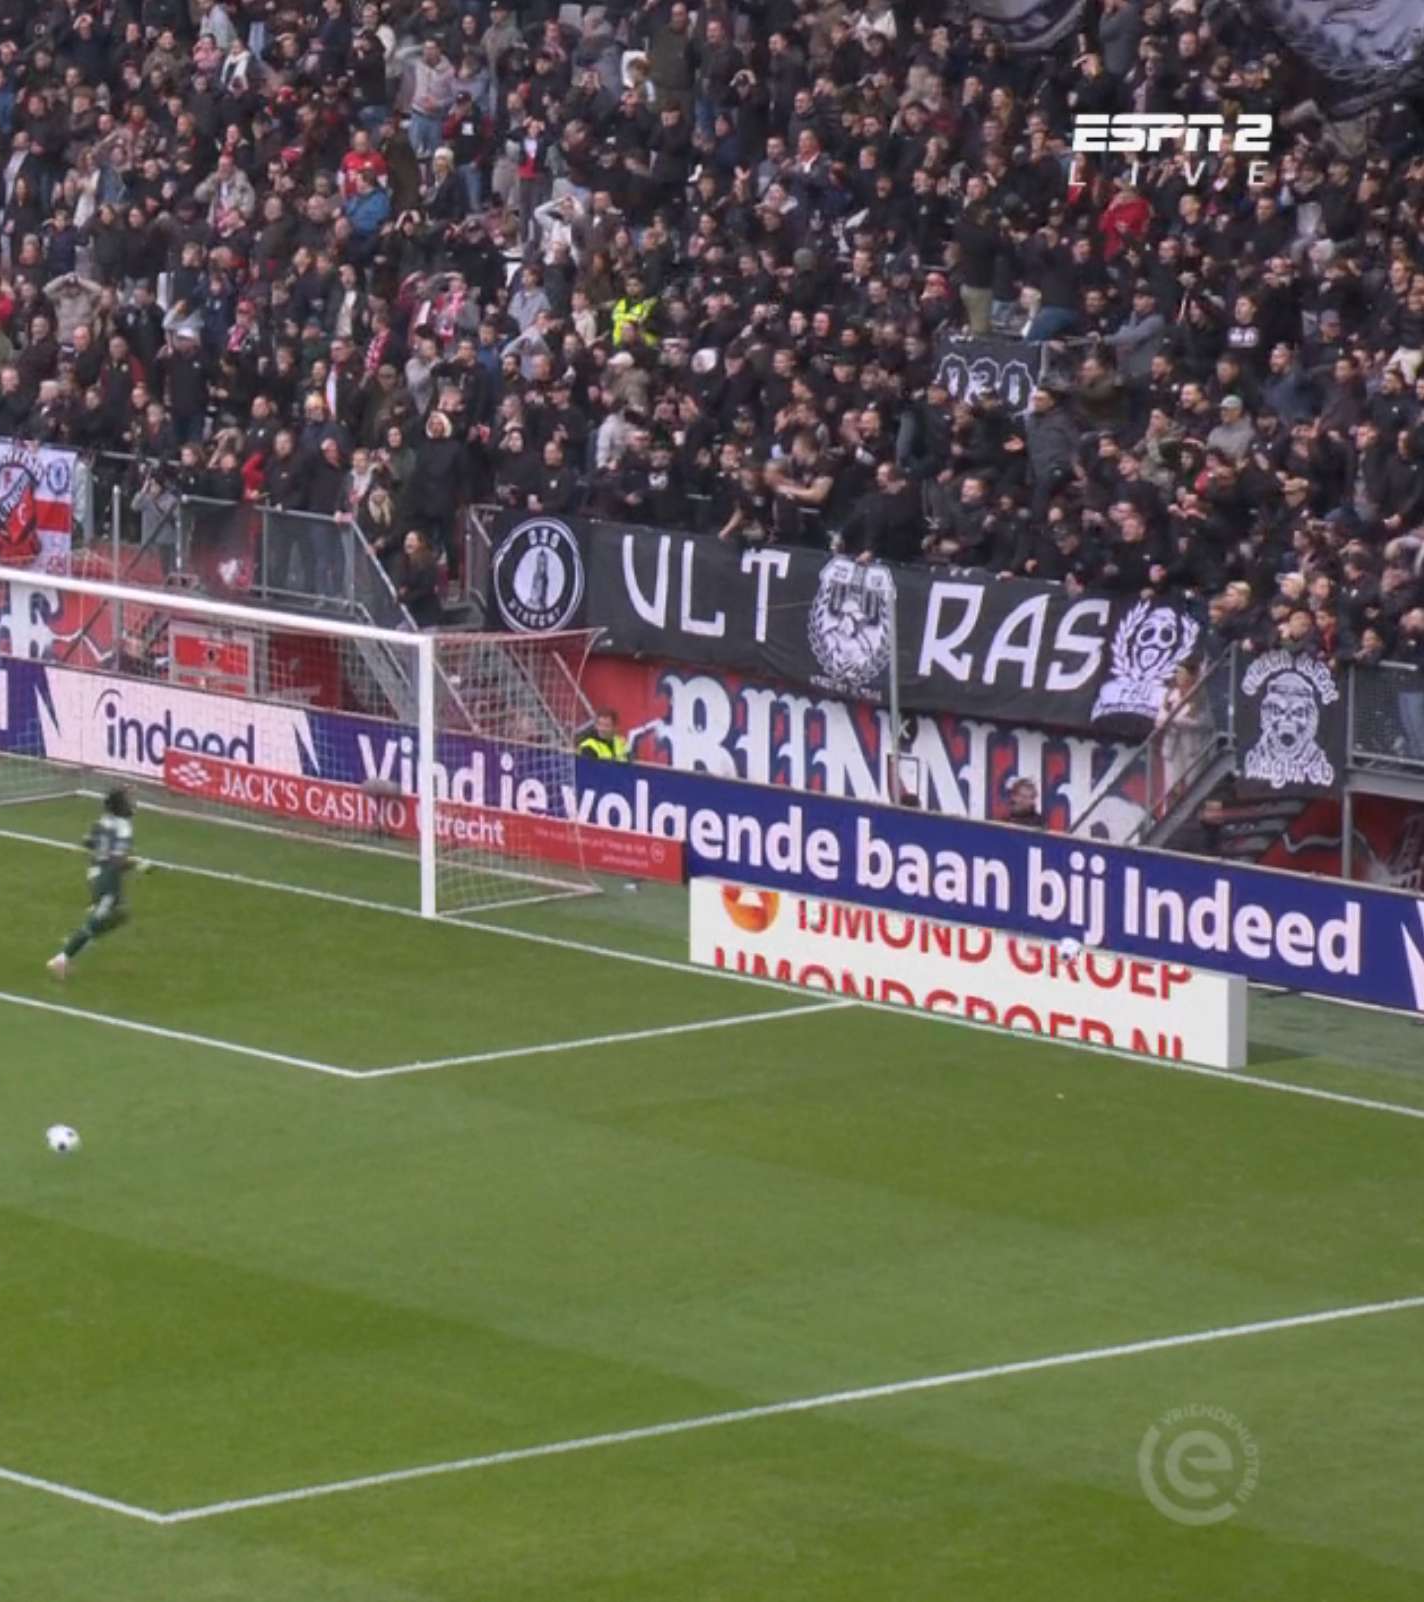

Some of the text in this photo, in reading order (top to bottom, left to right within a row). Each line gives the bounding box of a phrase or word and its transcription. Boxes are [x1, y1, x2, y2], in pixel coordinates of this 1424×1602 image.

[917, 581, 1111, 692] RAS
[220, 769, 299, 812] JACK'S
[305, 786, 407, 829] CASINO
[856, 816, 1011, 912] baan
[1027, 846, 1106, 946] bij
[1123, 867, 1361, 976] Indeed
